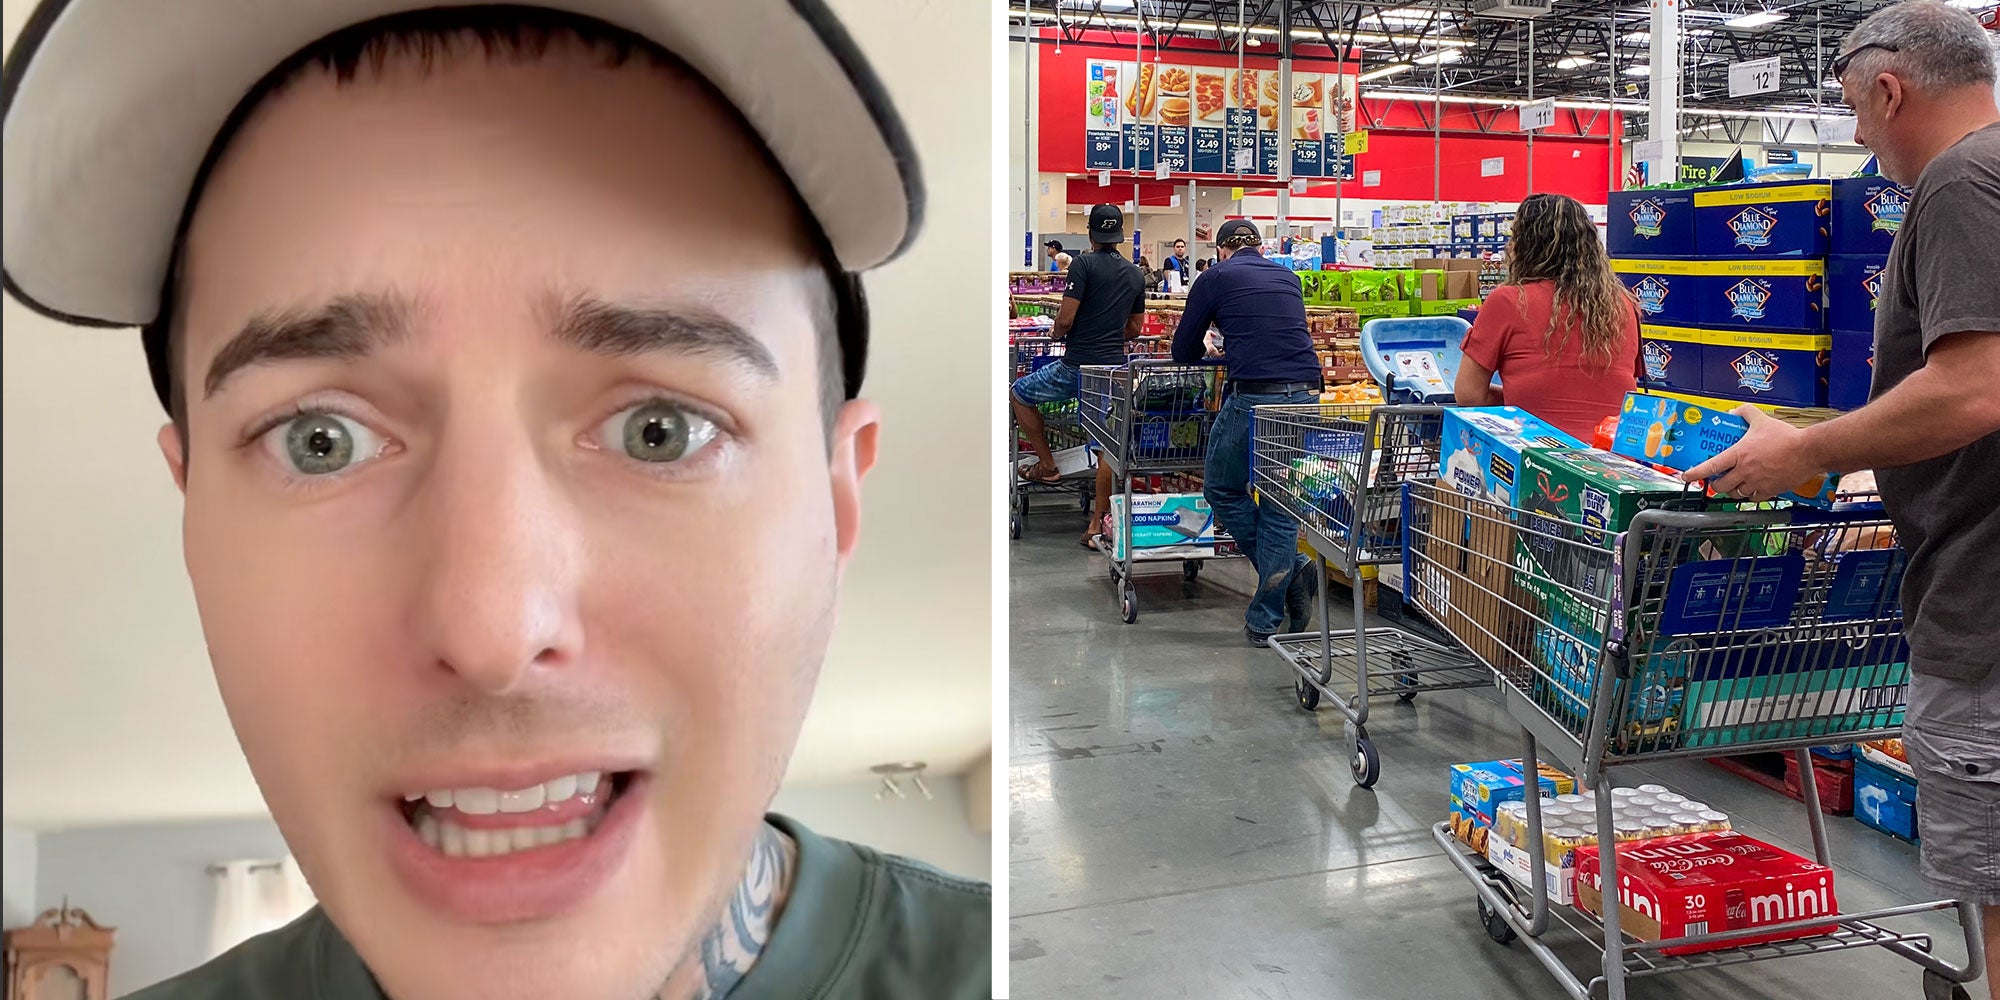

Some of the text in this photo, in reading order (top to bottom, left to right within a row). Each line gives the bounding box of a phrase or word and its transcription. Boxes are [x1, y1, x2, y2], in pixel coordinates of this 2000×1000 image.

[1231, 116, 1252, 124] $899
[1128, 137, 1149, 146] $150
[1162, 135, 1184, 144] $2.50
[1196, 139, 1219, 148] $2.49
[1229, 137, 1254, 146] $1399
[1096, 142, 1111, 151] 89¢
[1682, 165, 1706, 179] Tire
[1880, 194, 1900, 204] BLUE
[1640, 205, 1654, 214] BLUE
[1634, 212, 1661, 221] DIAMOND
[1742, 212, 1761, 223] BLUE
[1734, 220, 1771, 231] DIAMOND
[1643, 281, 1656, 290] BLUE
[1740, 284, 1756, 294] BLUE
[1637, 288, 1664, 298] DIAMOND
[1731, 292, 1765, 302] DIAMOND
[1645, 346, 1659, 356] BLUE
[1644, 355, 1667, 364] IAMOND
[1745, 355, 1762, 366] BLUE
[1737, 363, 1772, 375] DIAMOND
[1454, 467, 1480, 491] POWER
[1586, 490, 1606, 506] HEAVY
[1587, 499, 1604, 512] DUTY
[1619, 843, 1712, 863] mini
[1650, 854, 1734, 874] Coca-Cola
[1685, 894, 1705, 909] 30
[1751, 877, 1828, 923] mini
